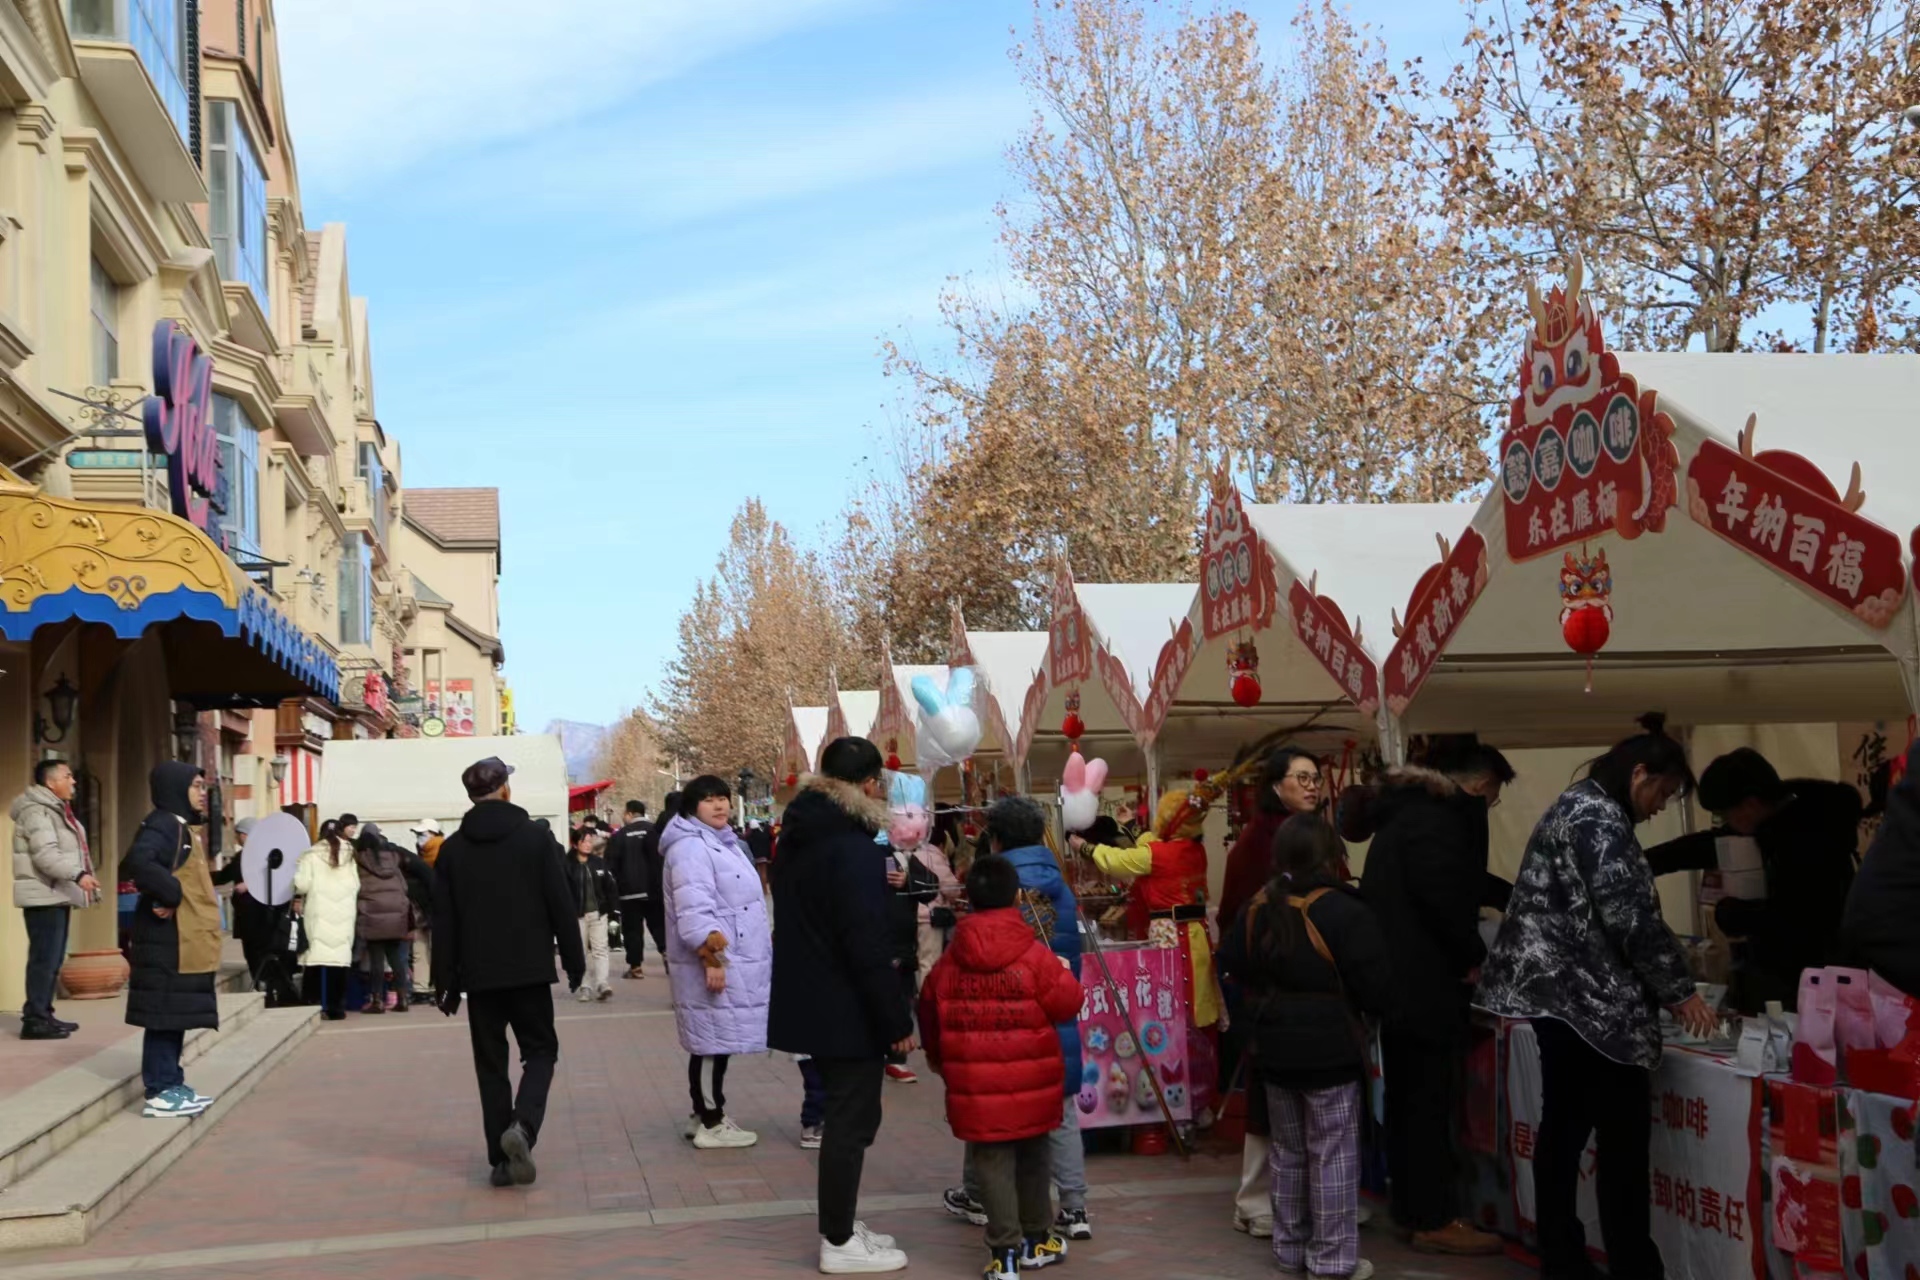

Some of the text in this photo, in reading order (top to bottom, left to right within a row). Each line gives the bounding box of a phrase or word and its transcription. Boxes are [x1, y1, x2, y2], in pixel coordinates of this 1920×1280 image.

[1716, 470, 1866, 600] 年纳百福
[1301, 603, 1364, 699] 年纳百福
[1650, 1168, 1746, 1241] 卸的责任
